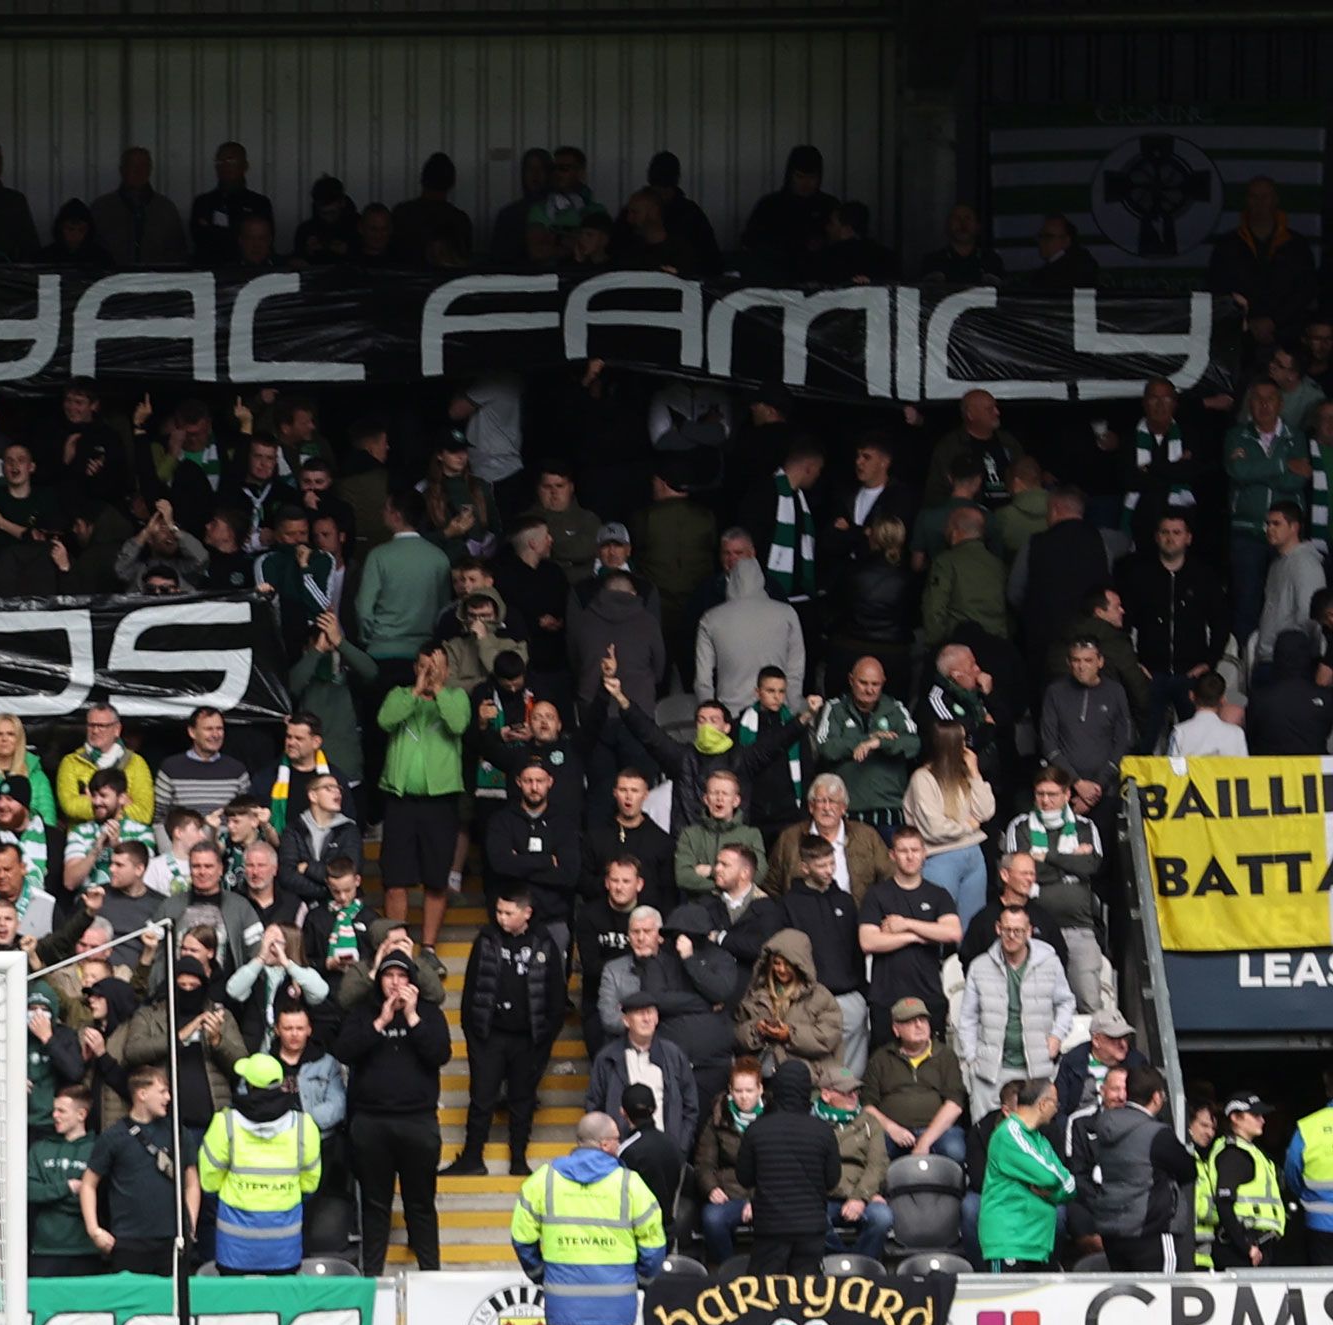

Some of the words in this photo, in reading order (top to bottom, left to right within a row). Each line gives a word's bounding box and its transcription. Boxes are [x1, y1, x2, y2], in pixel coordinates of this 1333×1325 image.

[1238, 951, 1333, 988] LEA
[237, 1181, 295, 1192] STEWARD
[556, 1236, 618, 1248] STEWARD
